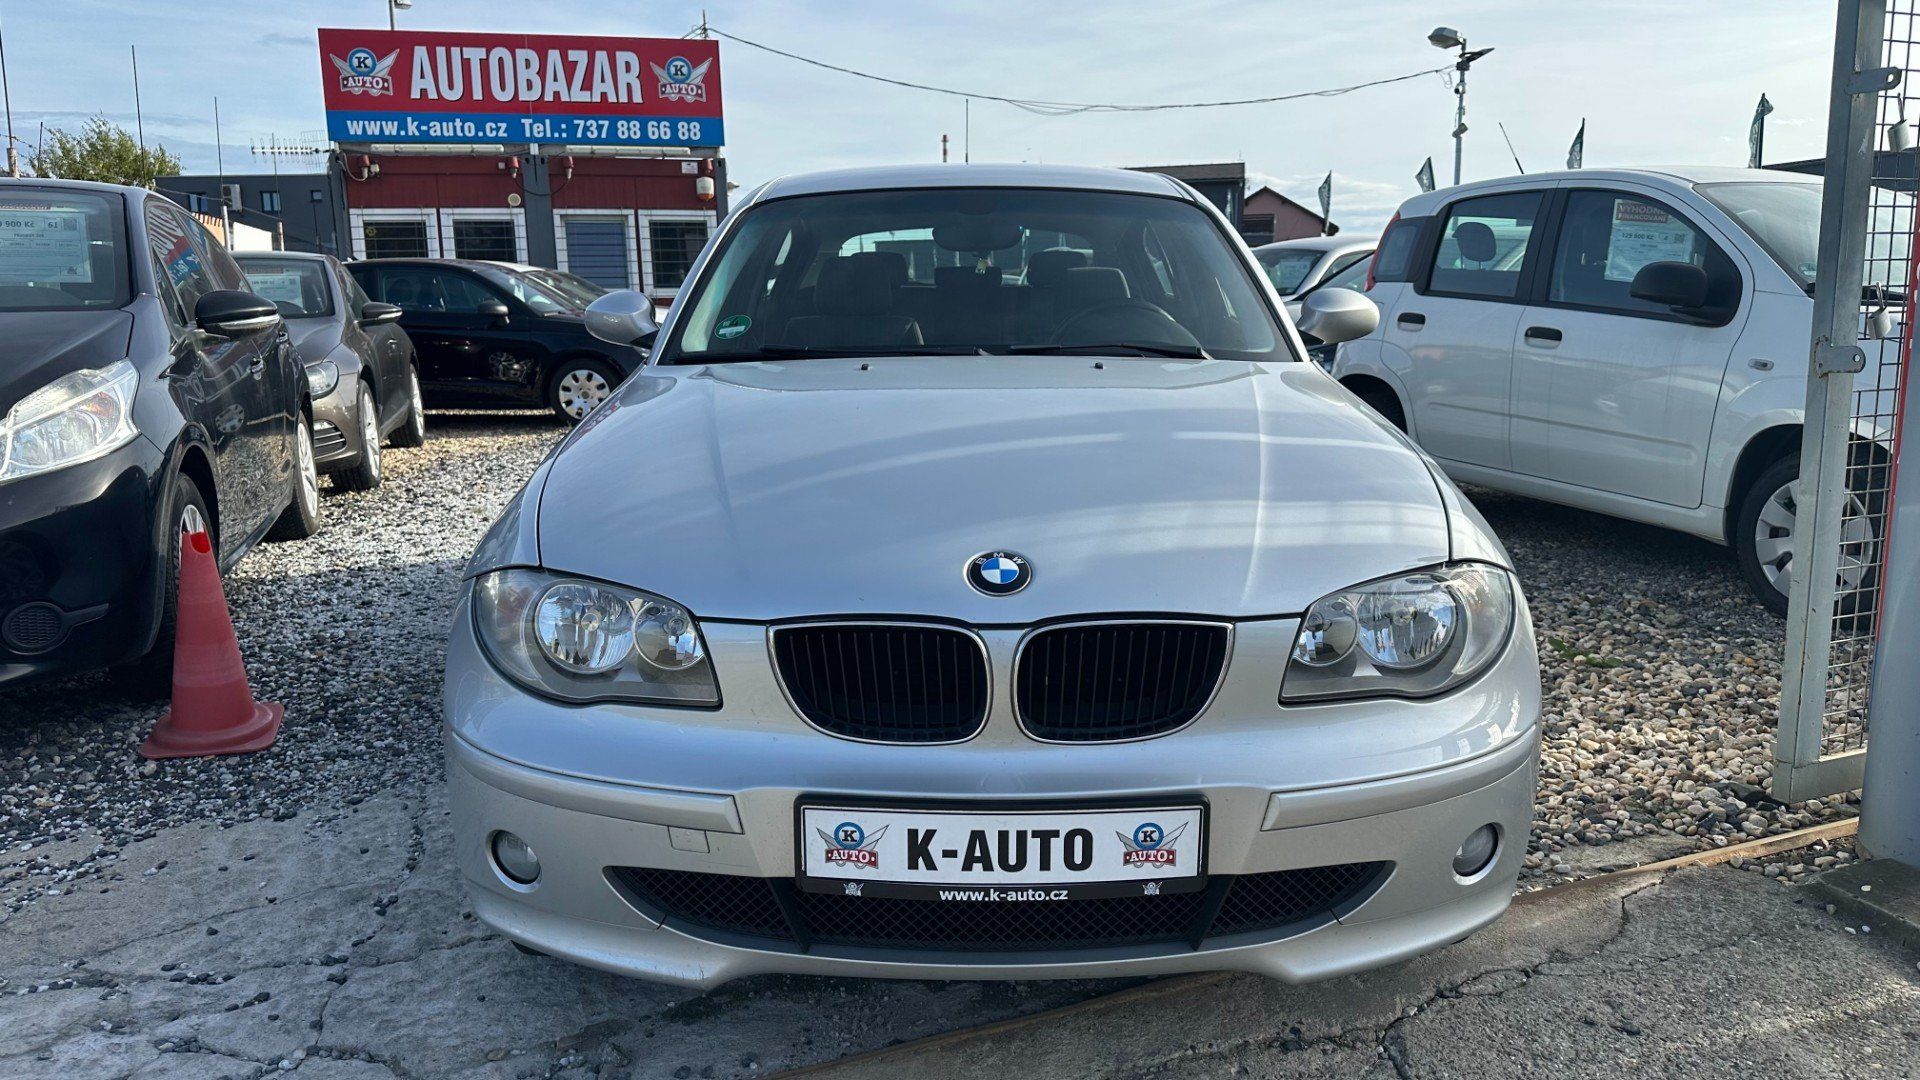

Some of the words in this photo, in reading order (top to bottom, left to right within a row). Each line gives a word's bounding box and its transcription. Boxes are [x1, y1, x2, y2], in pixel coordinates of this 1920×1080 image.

[354, 56, 371, 69] K
[410, 45, 644, 104] AUTOBAZAR
[672, 64, 686, 77] K
[347, 76, 384, 90] AUTO
[664, 83, 698, 96] AUTO
[346, 116, 508, 138] www.k-auto.cz
[520, 118, 567, 139] Tel.:
[573, 119, 610, 139] 737
[616, 120, 641, 140] 88
[647, 120, 671, 140] 66
[677, 121, 701, 141] 88
[975, 552, 1025, 565] BMW
[841, 829, 858, 843] K
[1140, 829, 1157, 843] K
[831, 849, 871, 863] AUTO
[907, 828, 1094, 873] K-AUTO
[1129, 849, 1169, 862] AUTO
[939, 888, 1069, 902] www.k-auto.cz
